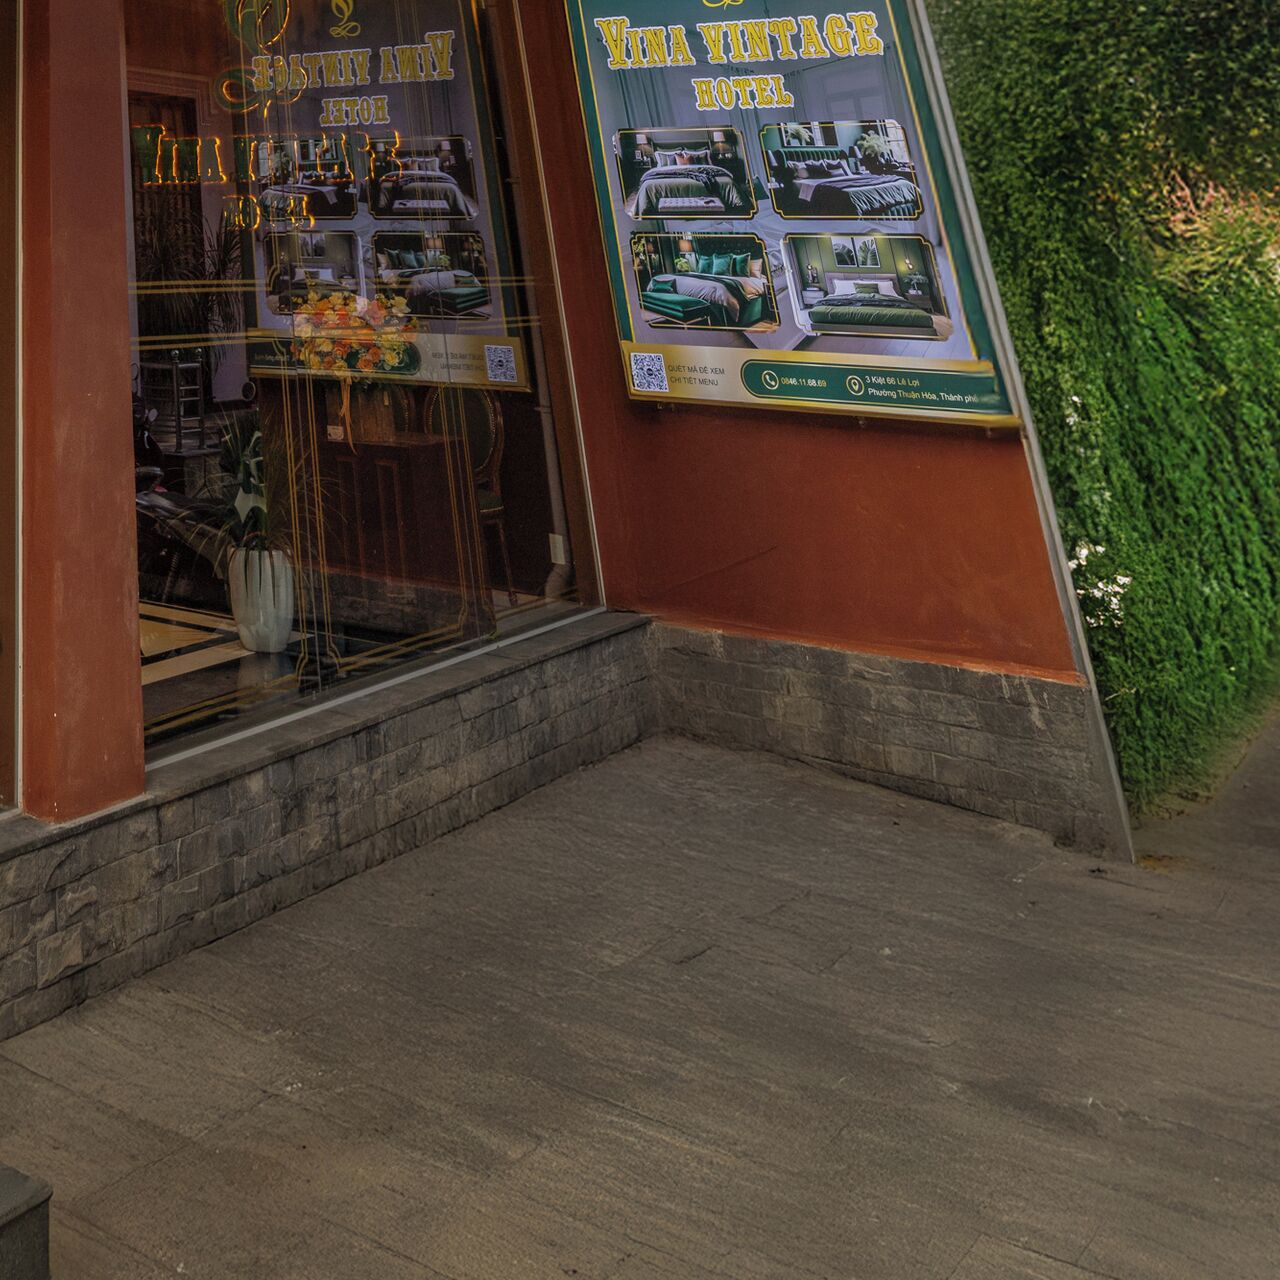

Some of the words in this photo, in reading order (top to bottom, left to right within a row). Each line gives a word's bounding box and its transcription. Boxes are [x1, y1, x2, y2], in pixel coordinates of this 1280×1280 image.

[594, 16, 697, 70] VINA
[697, 10, 885, 64] VINTAGE
[691, 73, 795, 111] HOTEL
[698, 378, 719, 386] MENU
[709, 367, 726, 375] XEM
